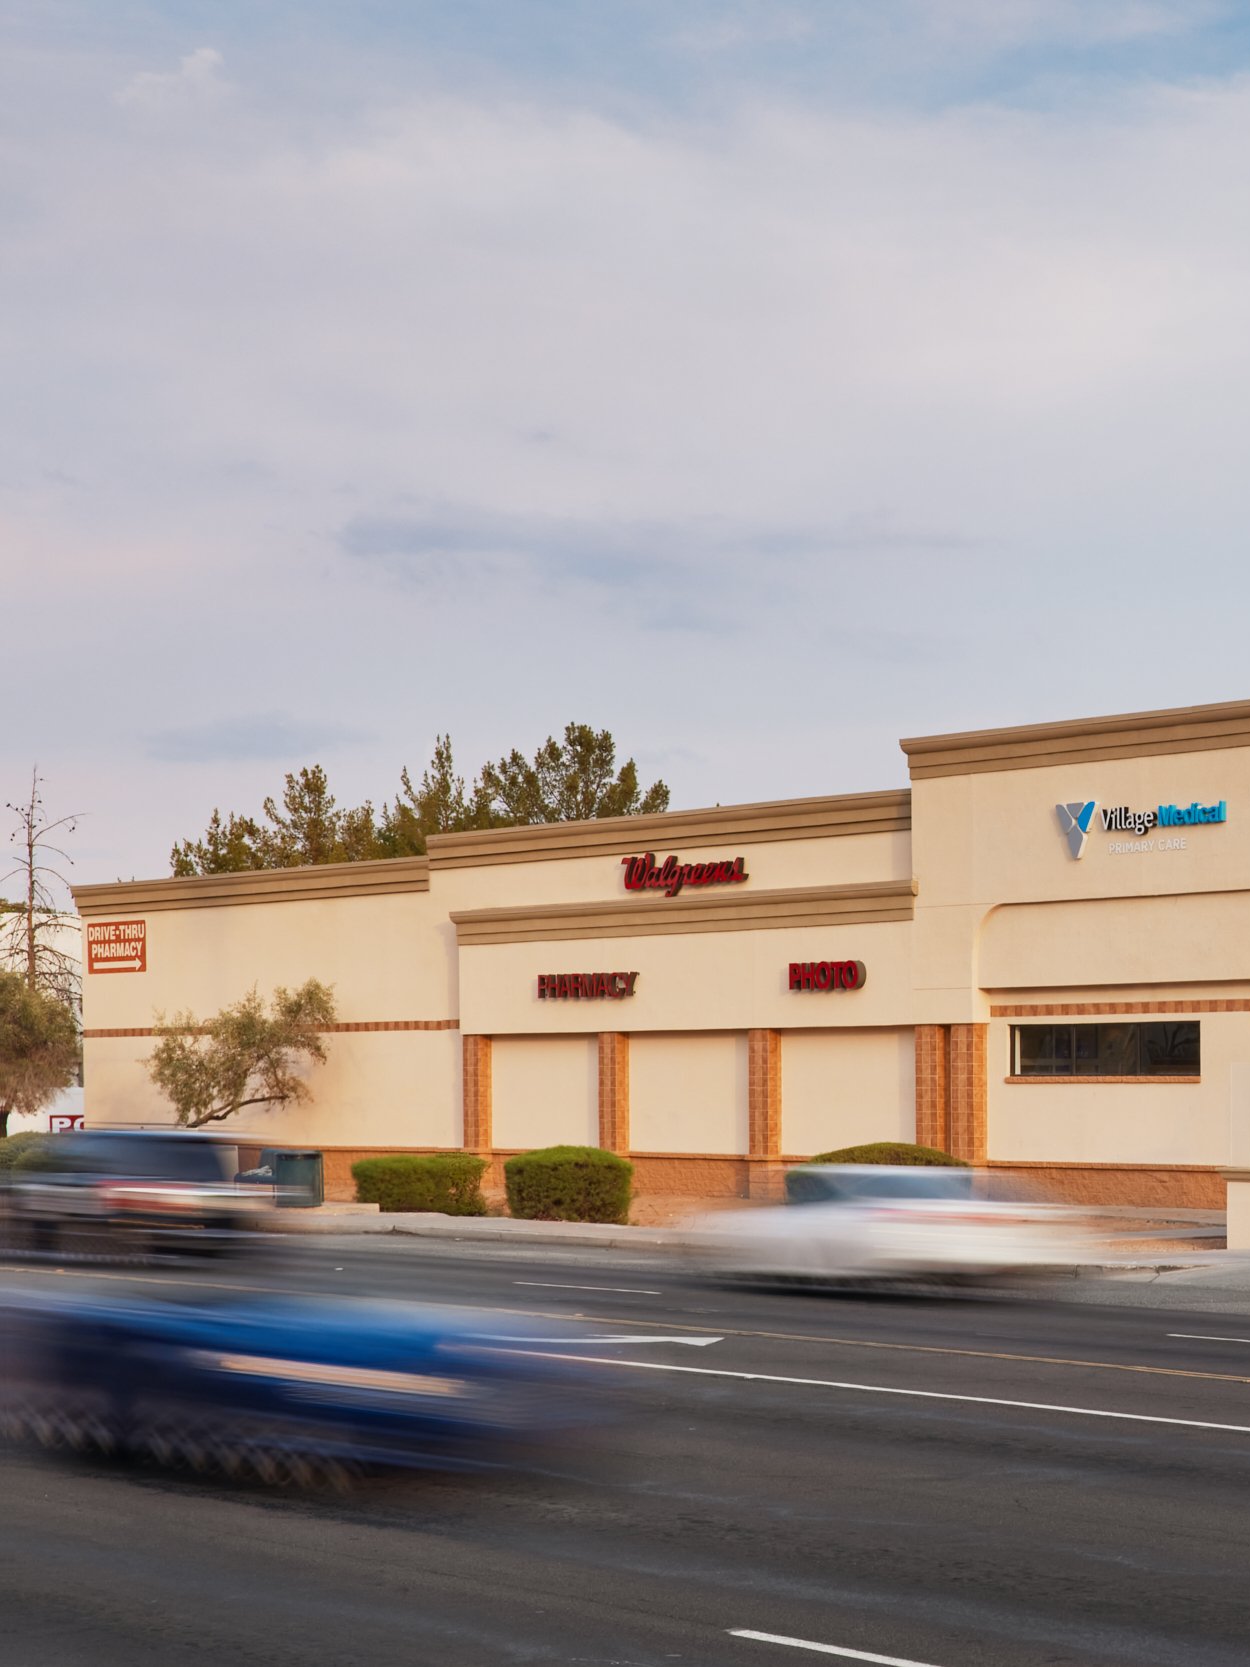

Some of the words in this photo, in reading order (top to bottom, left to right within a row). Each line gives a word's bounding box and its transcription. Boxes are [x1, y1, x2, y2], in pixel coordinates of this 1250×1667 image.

[1101, 806, 1155, 835] Village
[1157, 800, 1227, 827] Medical
[1108, 840, 1155, 855] PRIMARY
[1158, 837, 1188, 851] CARE
[621, 852, 750, 898] Walgreens
[88, 923, 145, 942] DRIVE-THRU
[91, 941, 143, 959] PHARMACY
[537, 971, 640, 1000] PHARMACY
[788, 960, 867, 991] PHOTO
